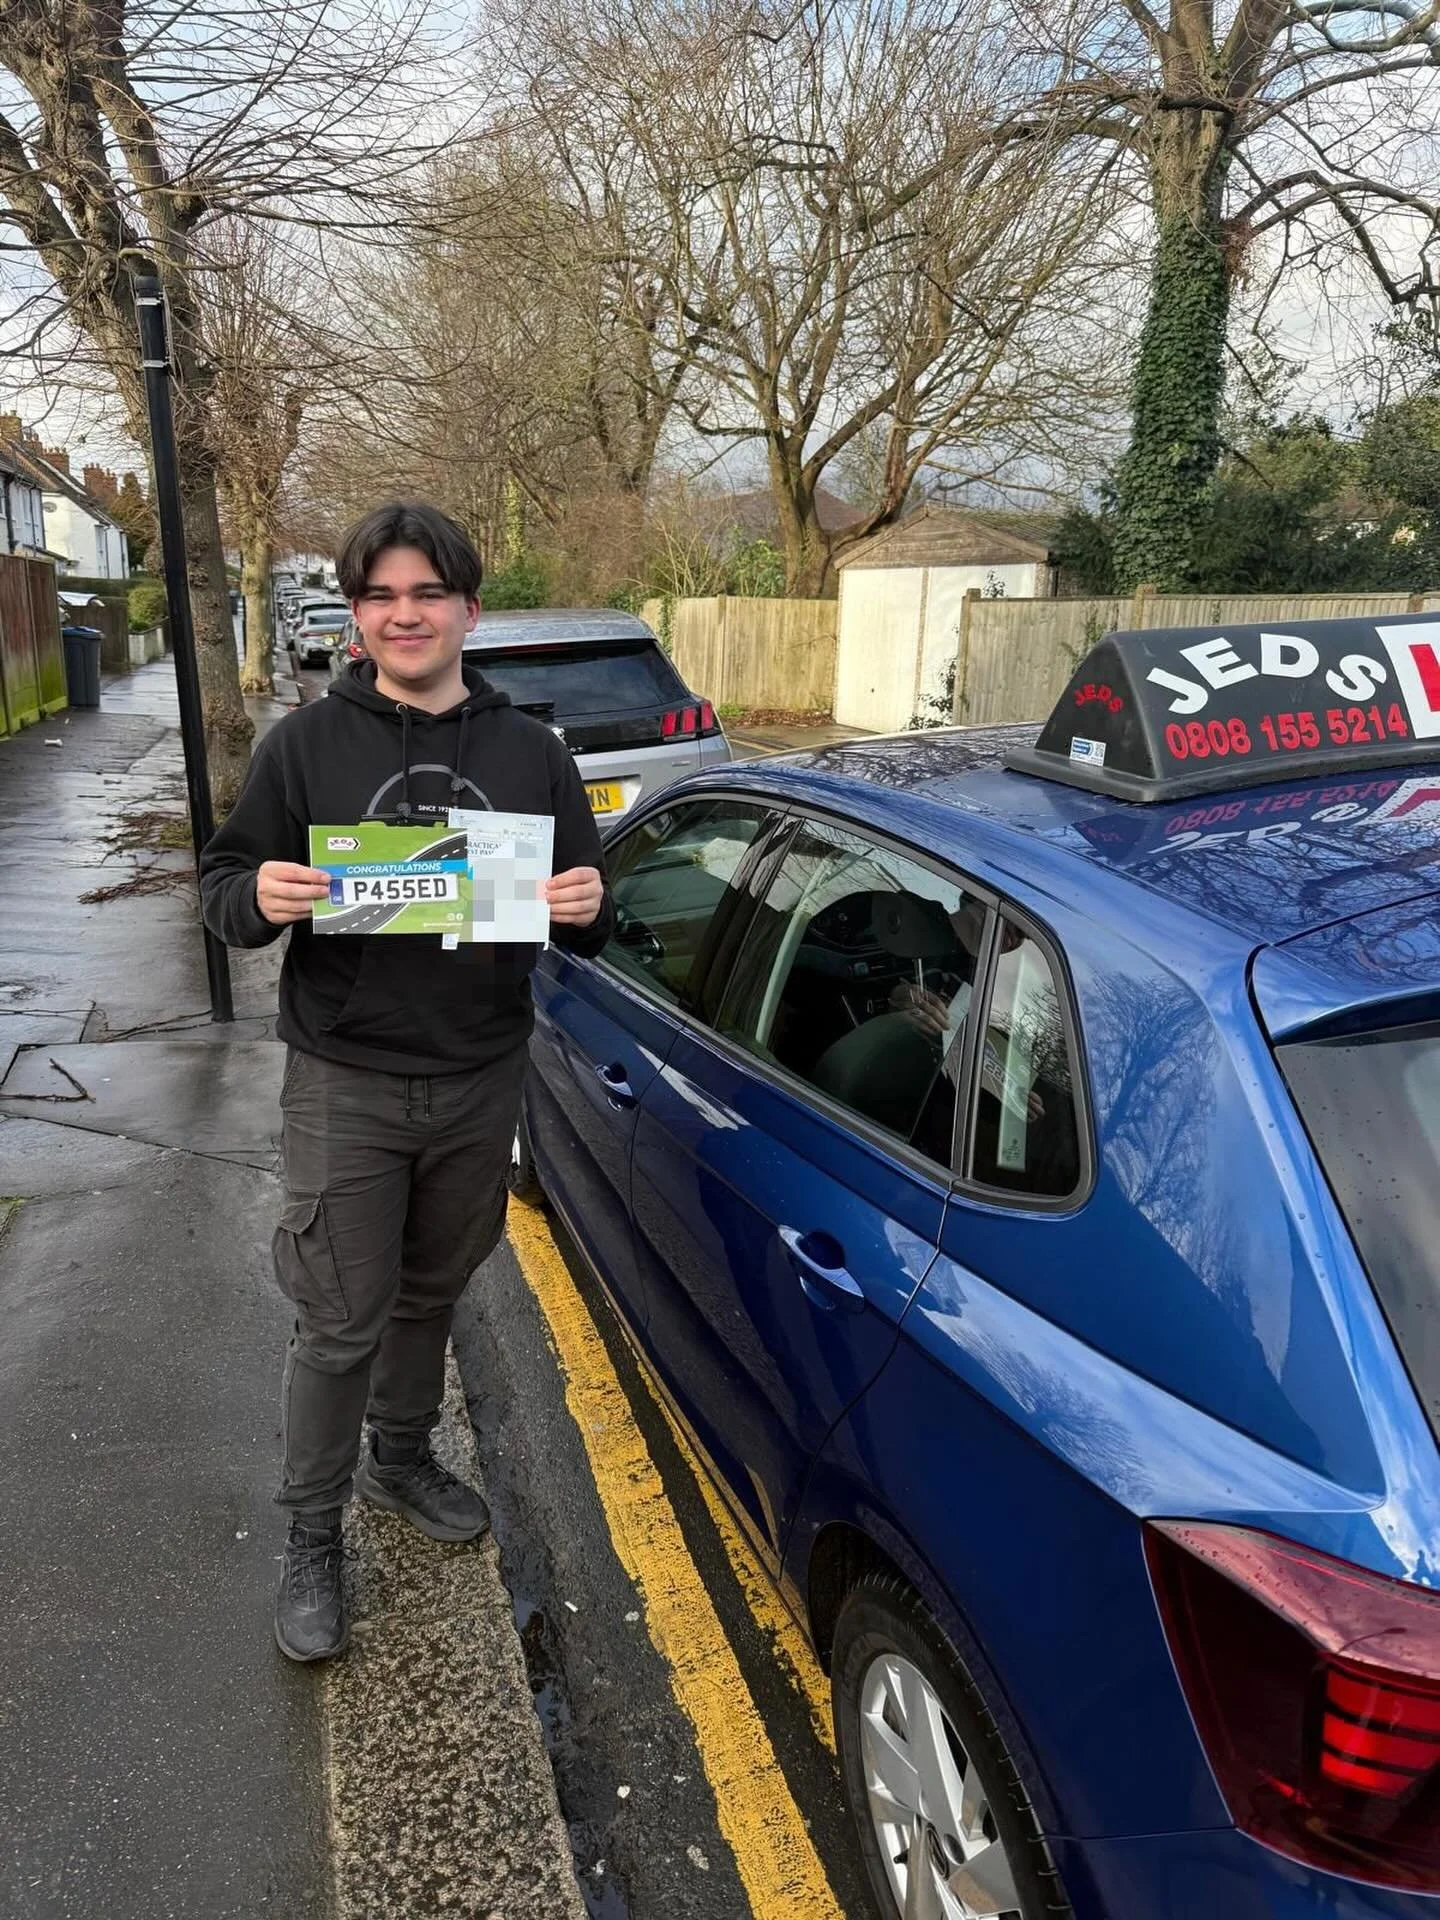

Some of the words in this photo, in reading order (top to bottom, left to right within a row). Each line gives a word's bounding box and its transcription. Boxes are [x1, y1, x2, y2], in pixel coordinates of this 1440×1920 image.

[1146, 633, 1387, 714] JEDS
[1074, 683, 1124, 712] JEDS
[1165, 718, 1252, 760] 0808
[1260, 711, 1321, 751] 155
[1326, 703, 1408, 745] 5214
[346, 862, 442, 875] CONGRATULATIONS
[354, 878, 447, 901] P455ED
